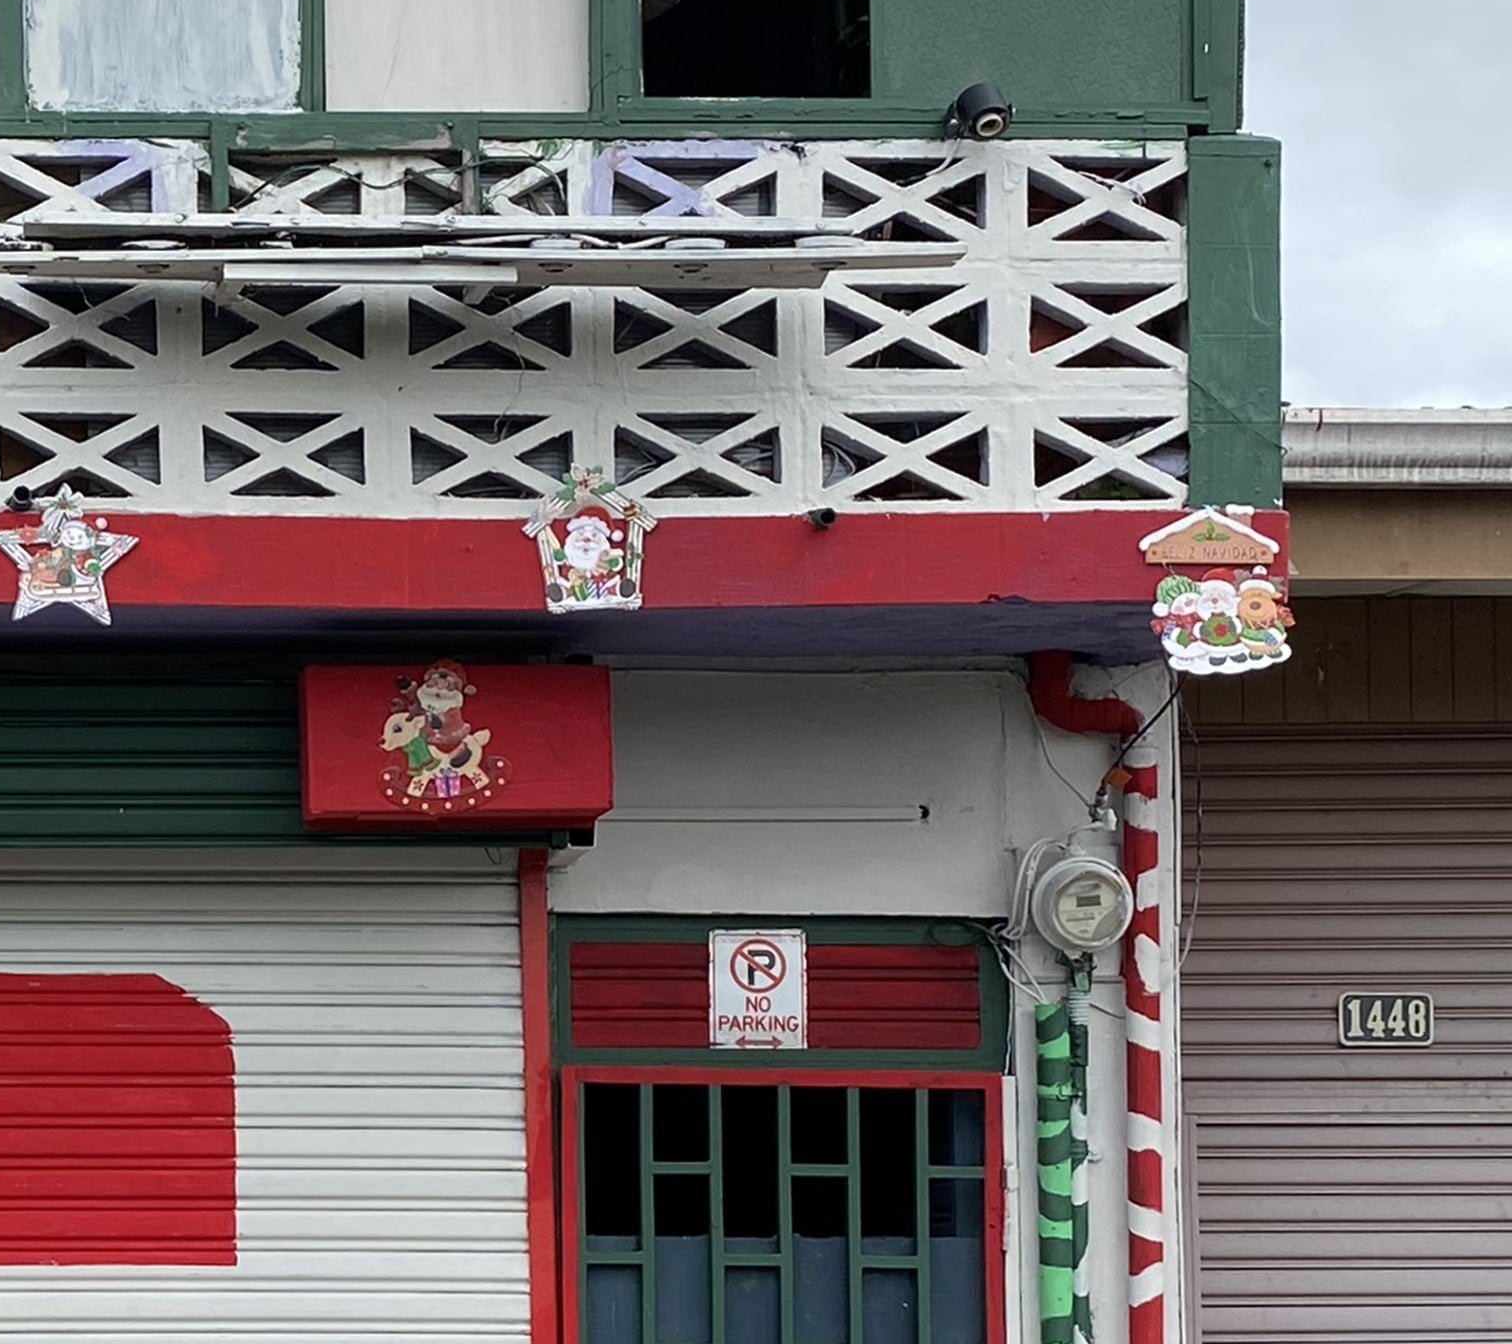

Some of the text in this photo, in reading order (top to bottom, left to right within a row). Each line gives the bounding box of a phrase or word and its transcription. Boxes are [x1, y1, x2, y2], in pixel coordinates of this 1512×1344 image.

[1203, 546, 1258, 560] NAVIDAD
[745, 996, 771, 1013] NO
[718, 1015, 799, 1033] PARKING
[1347, 999, 1426, 1037] 1448
